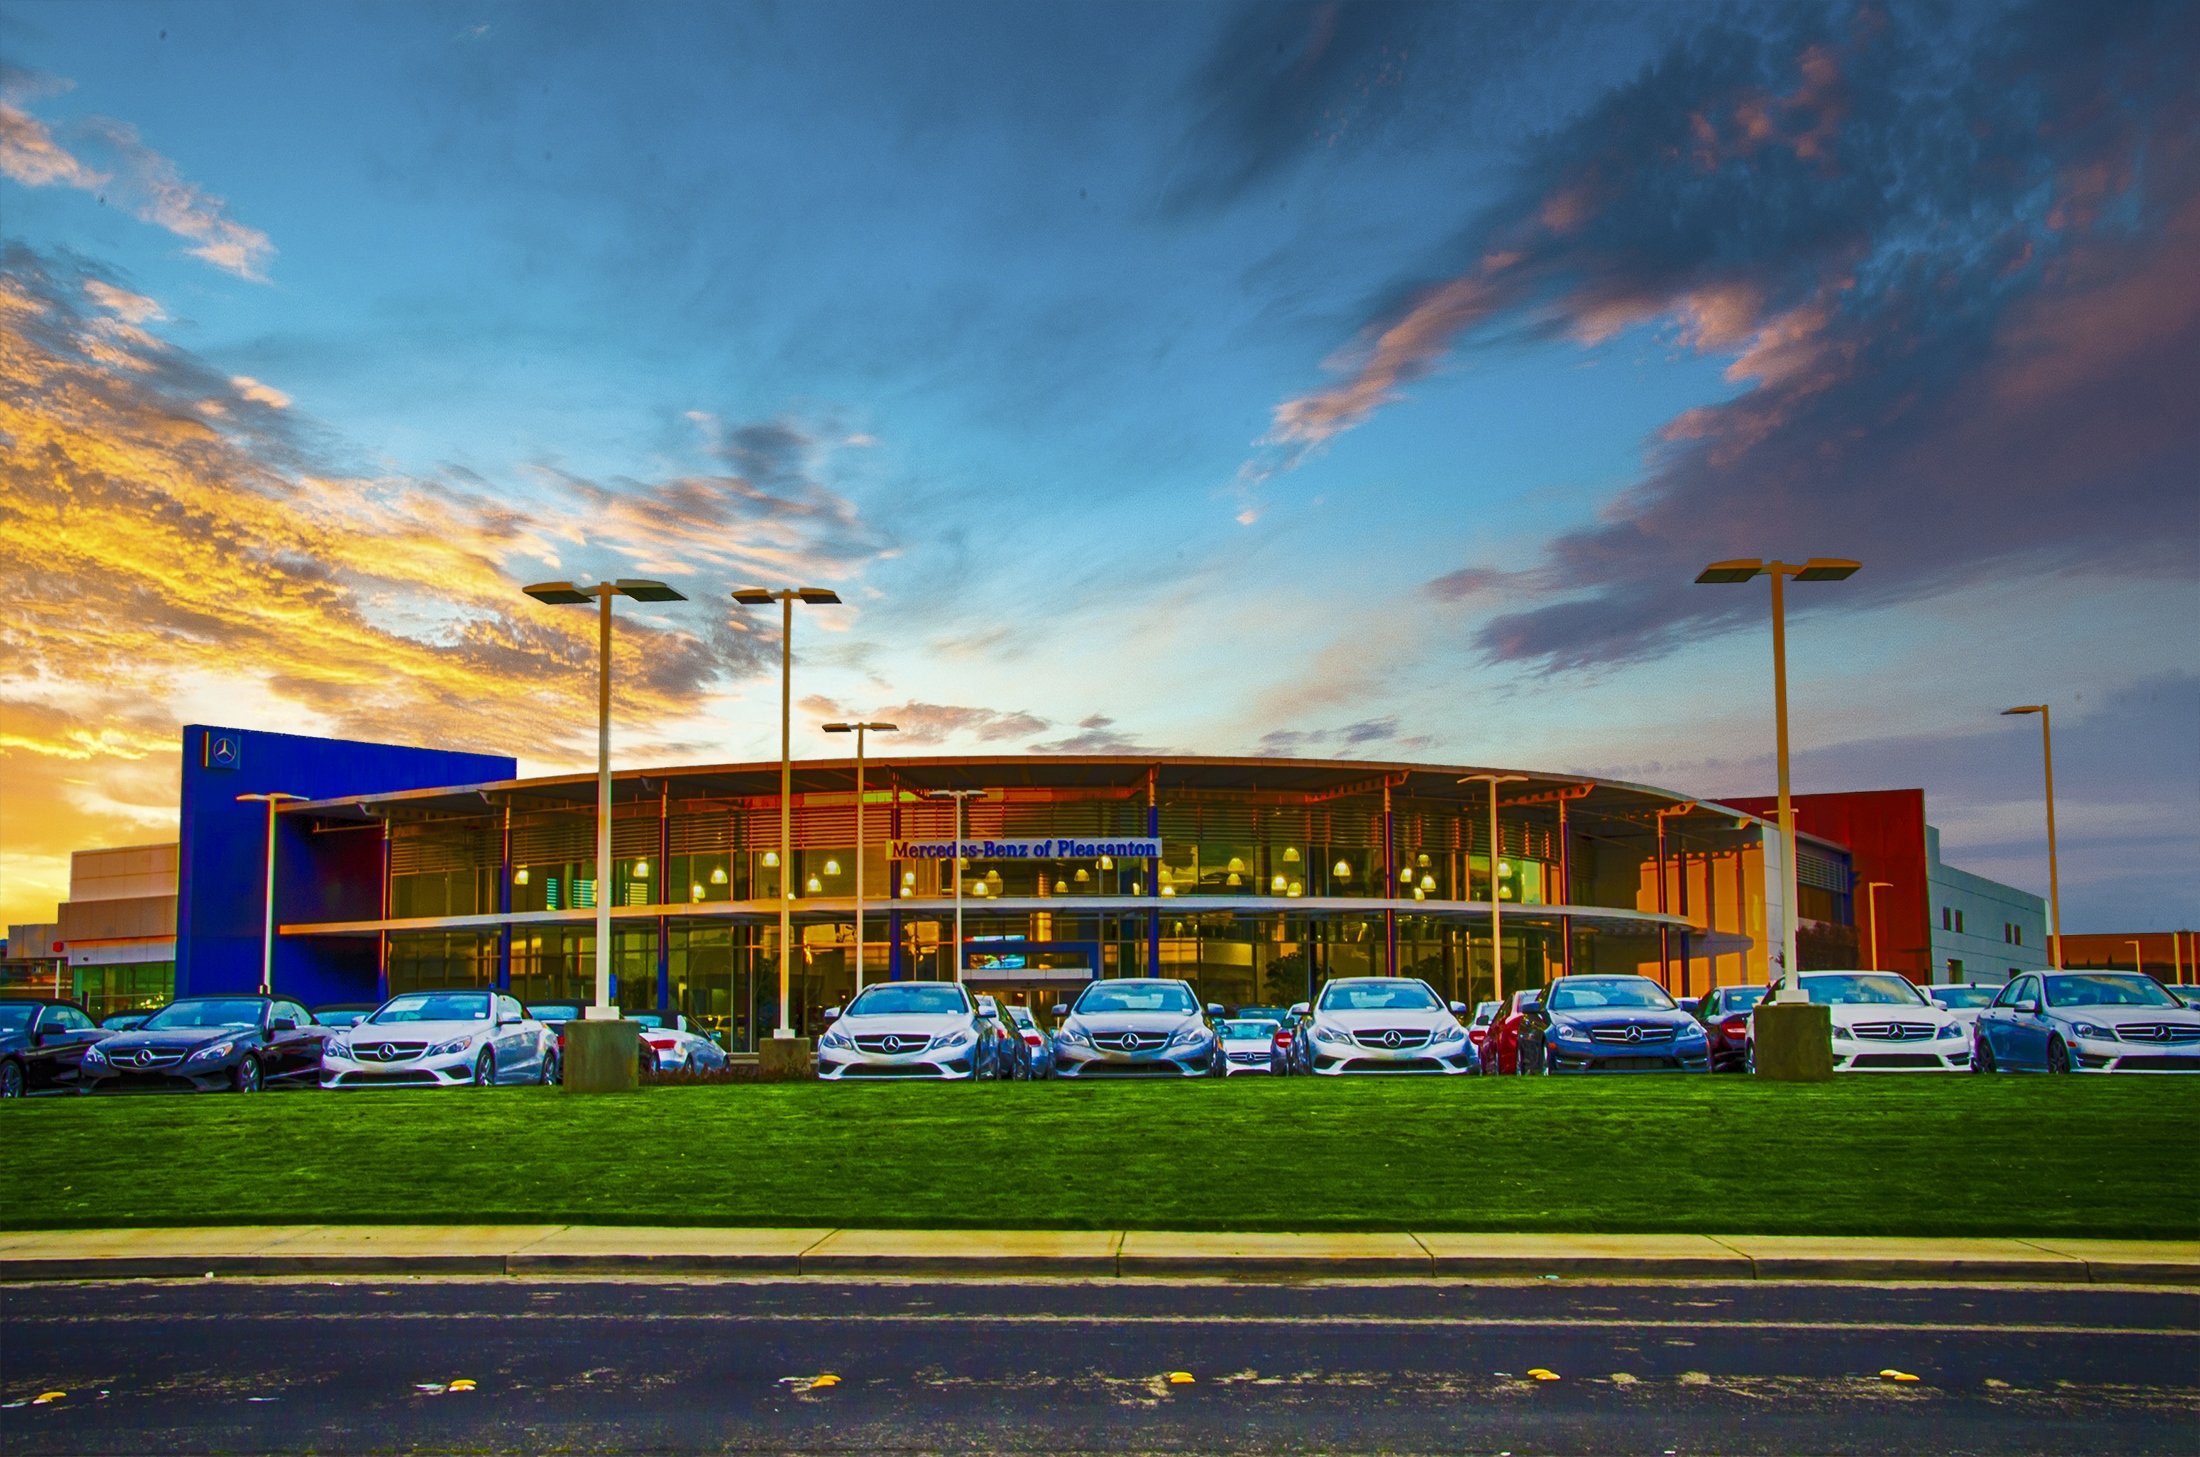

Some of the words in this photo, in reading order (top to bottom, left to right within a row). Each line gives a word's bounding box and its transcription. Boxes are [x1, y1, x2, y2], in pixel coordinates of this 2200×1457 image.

[893, 841, 1028, 858] Mercedes-Benz
[1033, 840, 1052, 857] of
[1057, 840, 1157, 857] Pleasanton
